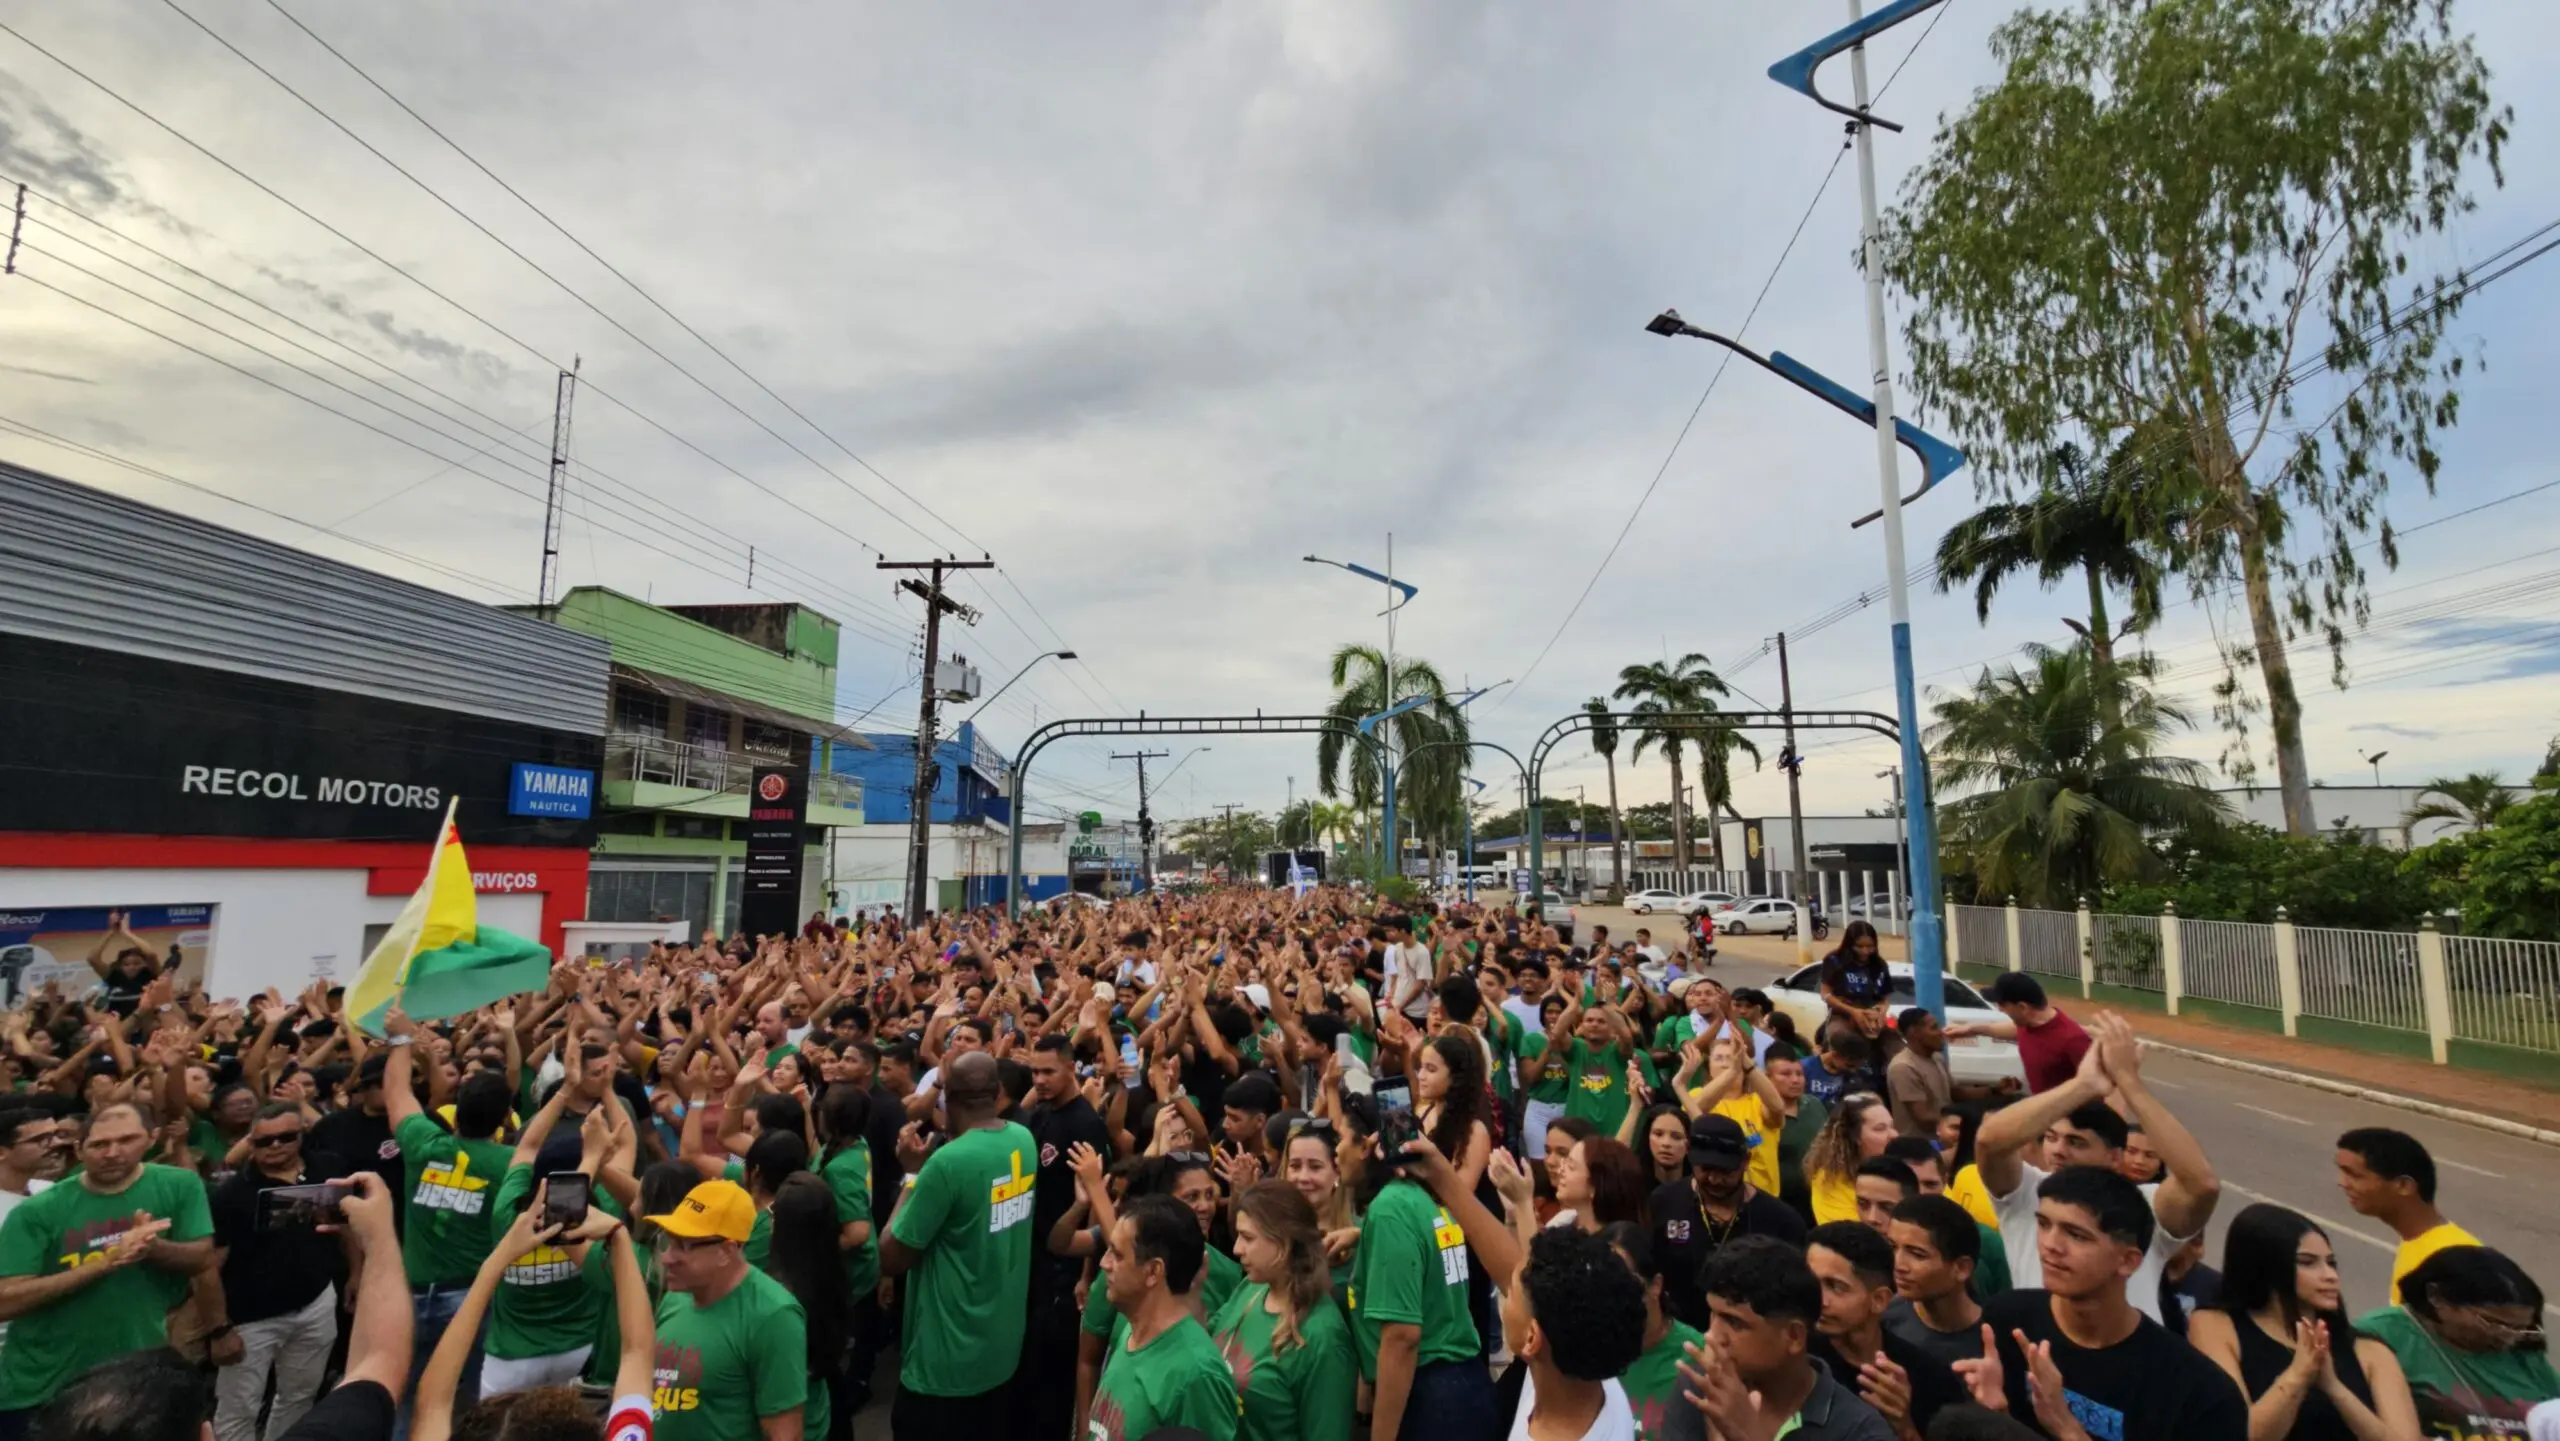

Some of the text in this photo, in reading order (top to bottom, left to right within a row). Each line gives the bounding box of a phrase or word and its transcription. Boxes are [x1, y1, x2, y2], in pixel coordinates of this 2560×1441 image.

[182, 764, 441, 810] RECOL MOTORS
[523, 769, 589, 798] YAMAHA
[472, 872, 537, 893] RVIÇOS
